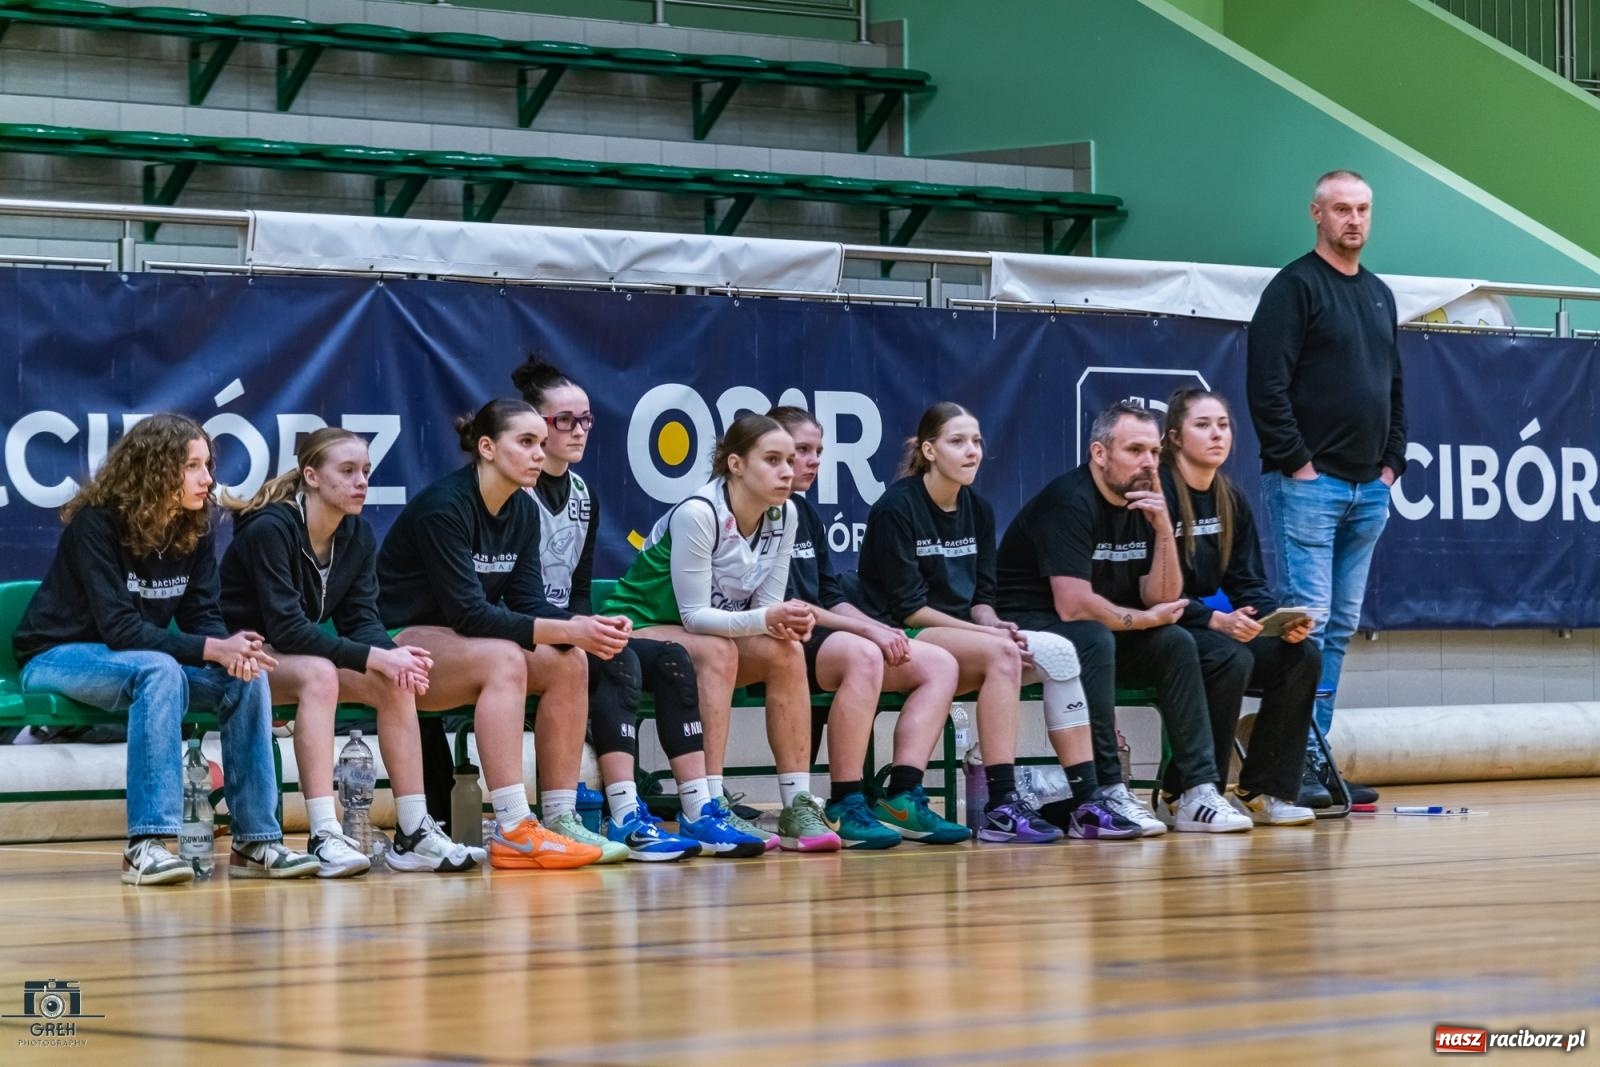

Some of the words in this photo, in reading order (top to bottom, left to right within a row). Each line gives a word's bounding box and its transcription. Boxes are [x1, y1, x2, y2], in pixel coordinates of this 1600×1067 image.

[0, 378, 406, 508] CIÓRZ
[627, 383, 886, 507] OR
[1387, 417, 1600, 522] CIBÓR
[568, 499, 591, 521] 85
[761, 529, 784, 555] 77
[824, 511, 868, 553] ÓR
